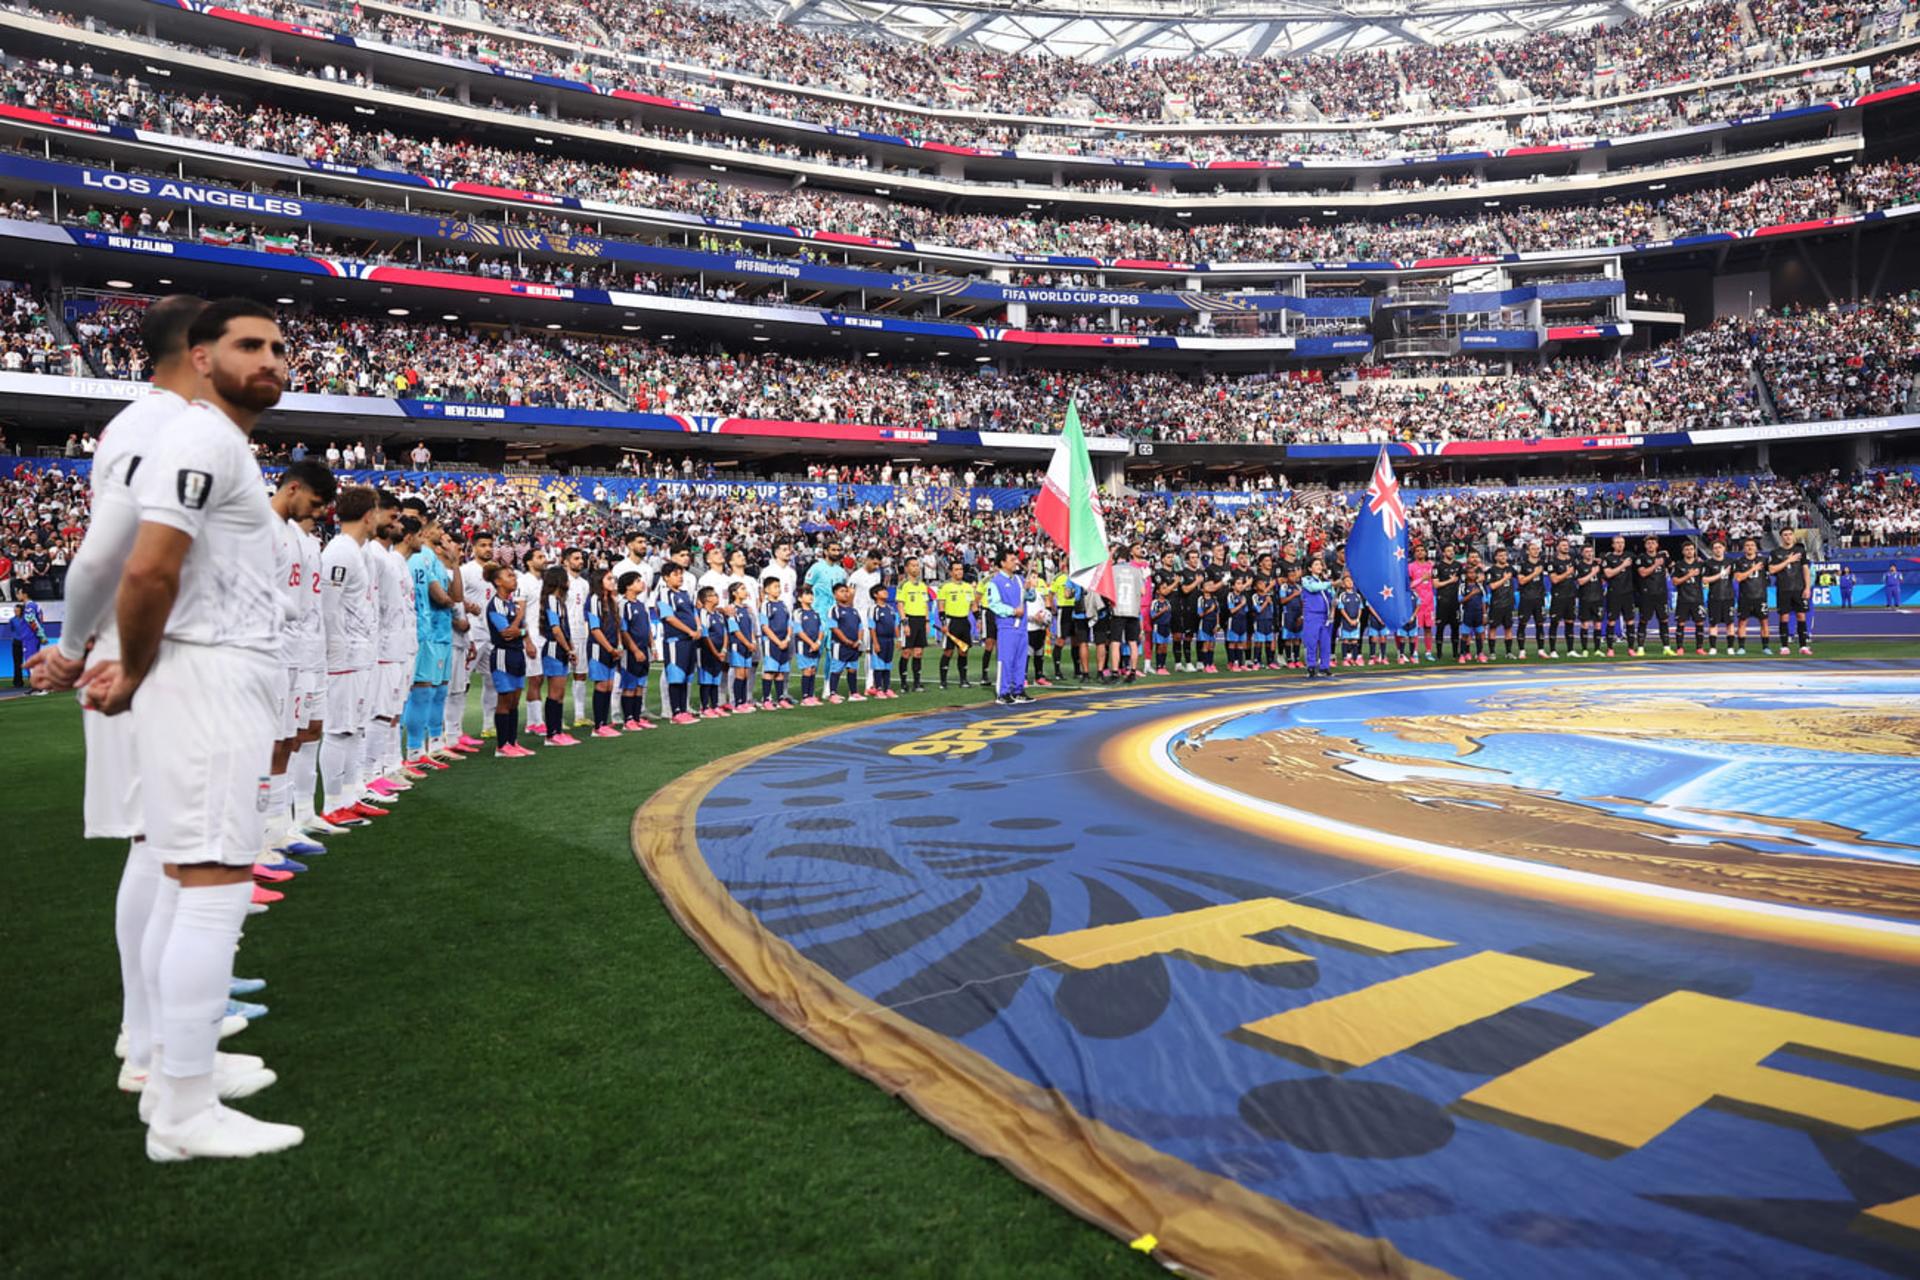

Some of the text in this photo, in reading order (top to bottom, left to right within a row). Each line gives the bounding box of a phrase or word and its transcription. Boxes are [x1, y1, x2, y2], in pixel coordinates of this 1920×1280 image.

[83, 171, 302, 216] LOS ANGELES
[108, 236, 174, 253] NEW ZEALAND
[735, 259, 800, 278] #FIFAWorldCup
[526, 285, 574, 299] NEW ZEALAND
[1002, 288, 1139, 305] FIFA WORLD CUP 2026
[444, 405, 505, 418] NEW ZEALAND
[312, 572, 321, 594] 2
[415, 568, 425, 584] 12
[888, 709, 1098, 756] 2026
[1014, 897, 1920, 1232] FIF
